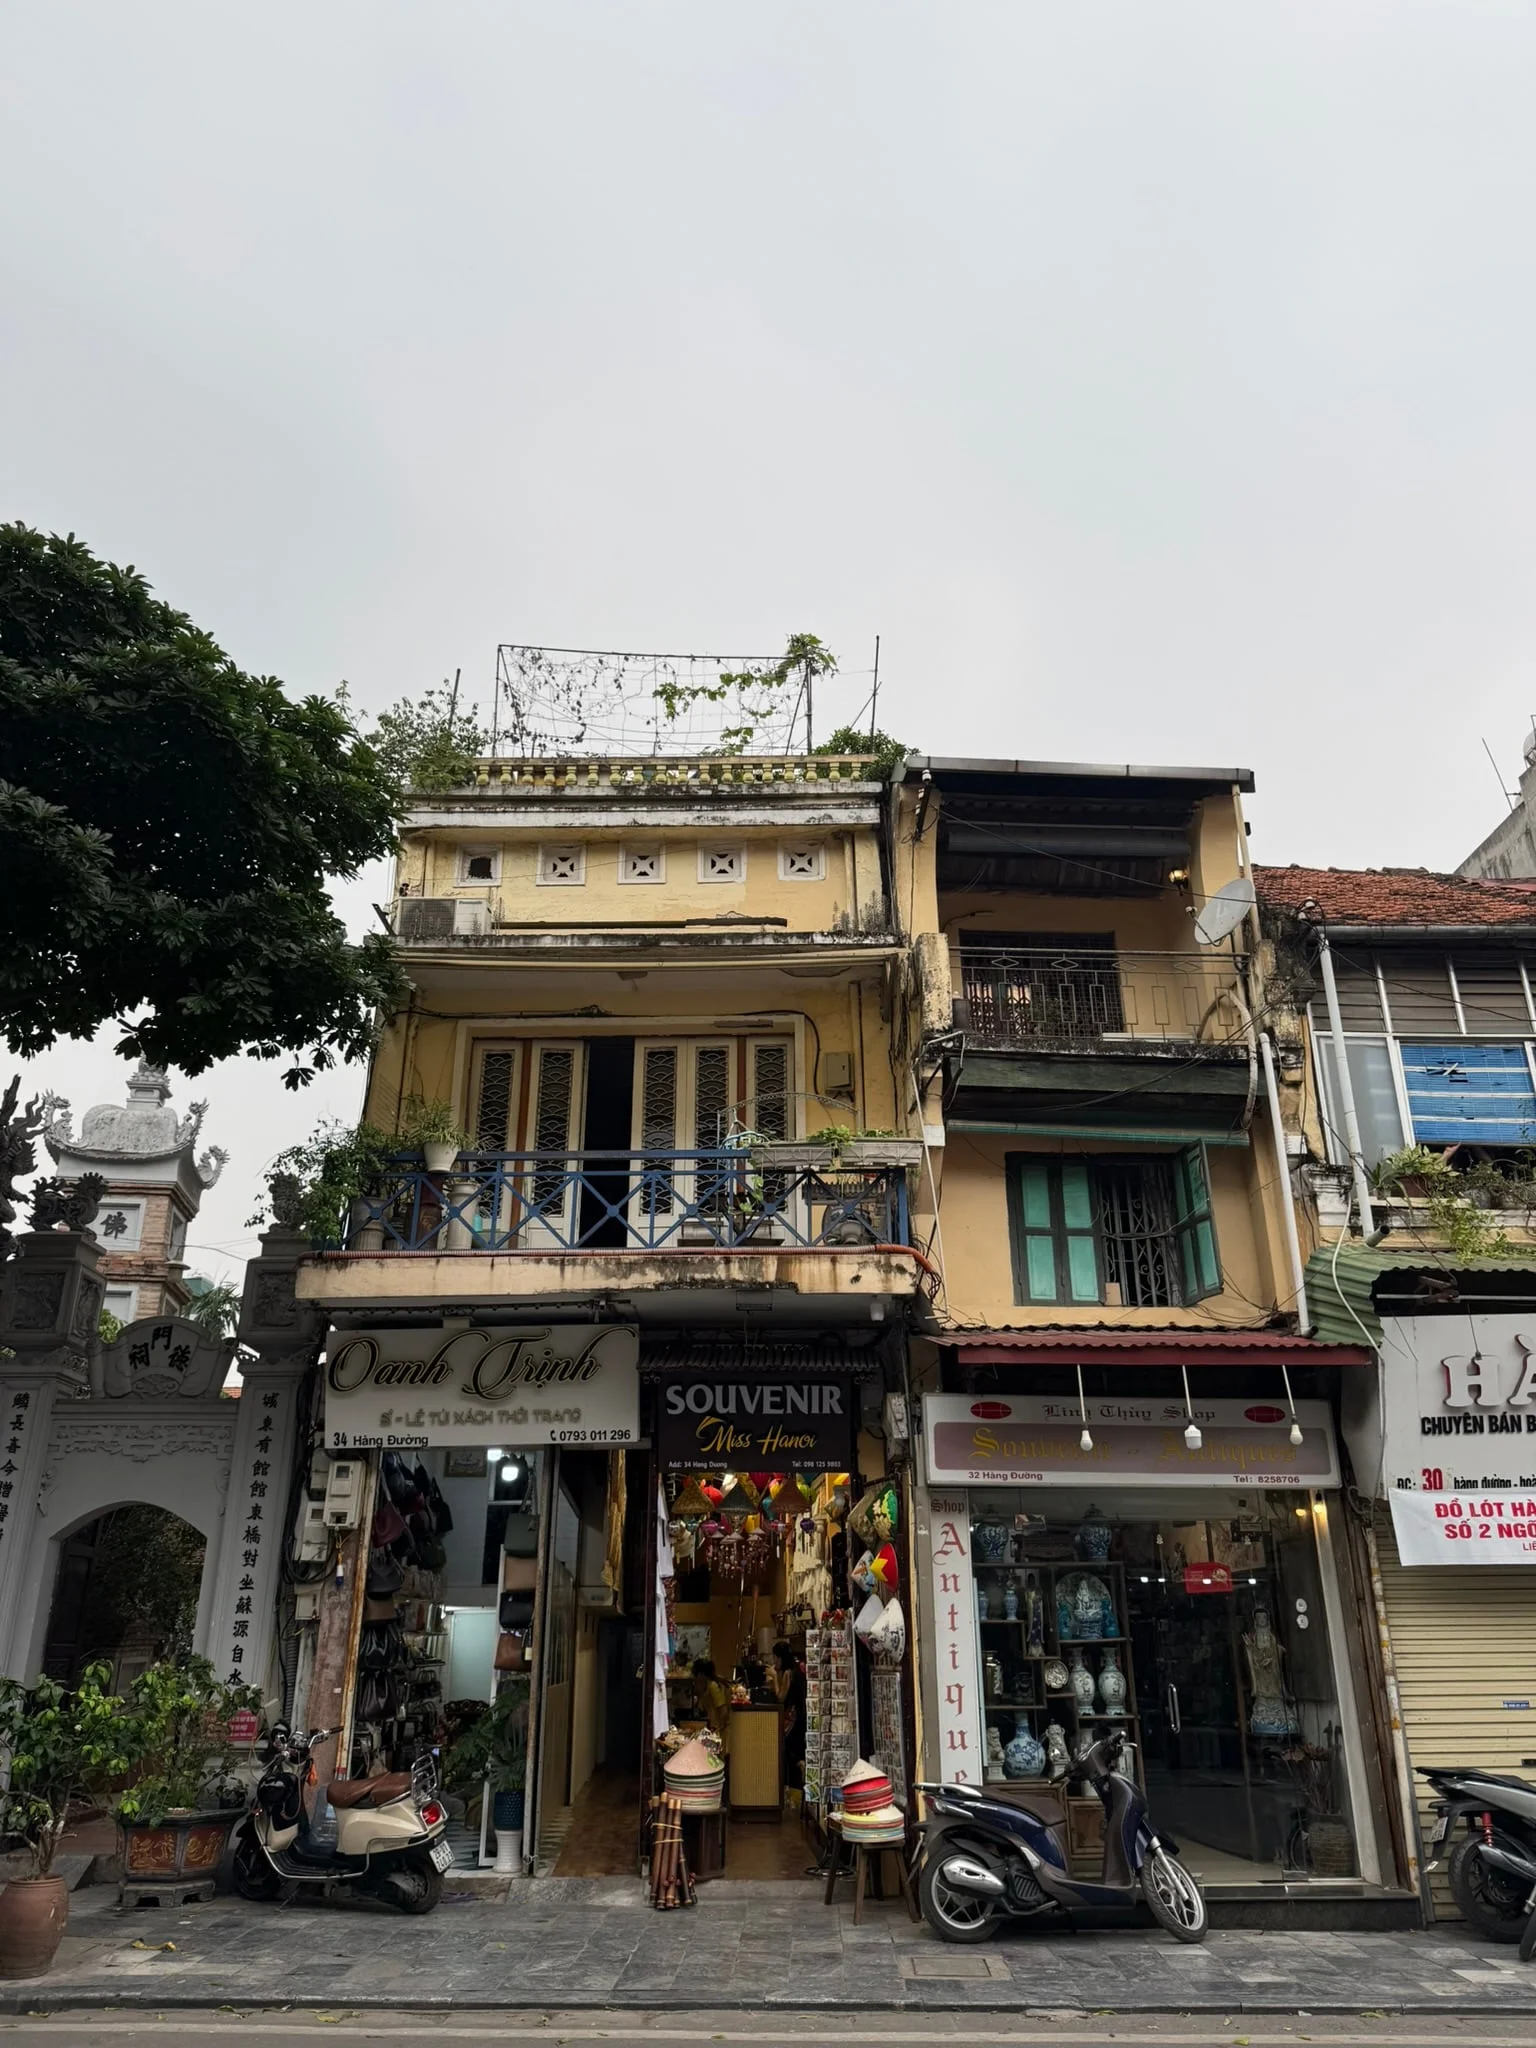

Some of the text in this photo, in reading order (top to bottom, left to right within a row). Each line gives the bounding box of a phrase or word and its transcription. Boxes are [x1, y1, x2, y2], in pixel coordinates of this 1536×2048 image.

[328, 1327, 637, 1400] Oanh Trịnh
[665, 1384, 844, 1415] SOUVENIR
[454, 1408, 493, 1426] XÁCH
[533, 1407, 582, 1424] TRANG
[1421, 1411, 1484, 1435] CHUYÊN
[1488, 1411, 1522, 1433] BÁN
[333, 1432, 428, 1449] 34 Hàng Đường
[559, 1429, 631, 1441] 0793 011 296
[698, 1424, 818, 1455] Miss Hanoi
[709, 1460, 728, 1469] Duong
[968, 1471, 1043, 1480] 32 Hàng Đường
[1233, 1475, 1300, 1483] Tel: 8258706
[1422, 1468, 1443, 1490] 30
[931, 1499, 965, 1513] Shop
[1435, 1497, 1463, 1518] ĐỒ
[1469, 1499, 1504, 1517] LÓT
[1445, 1518, 1472, 1539] SỐ
[1479, 1523, 1492, 1538] 2
